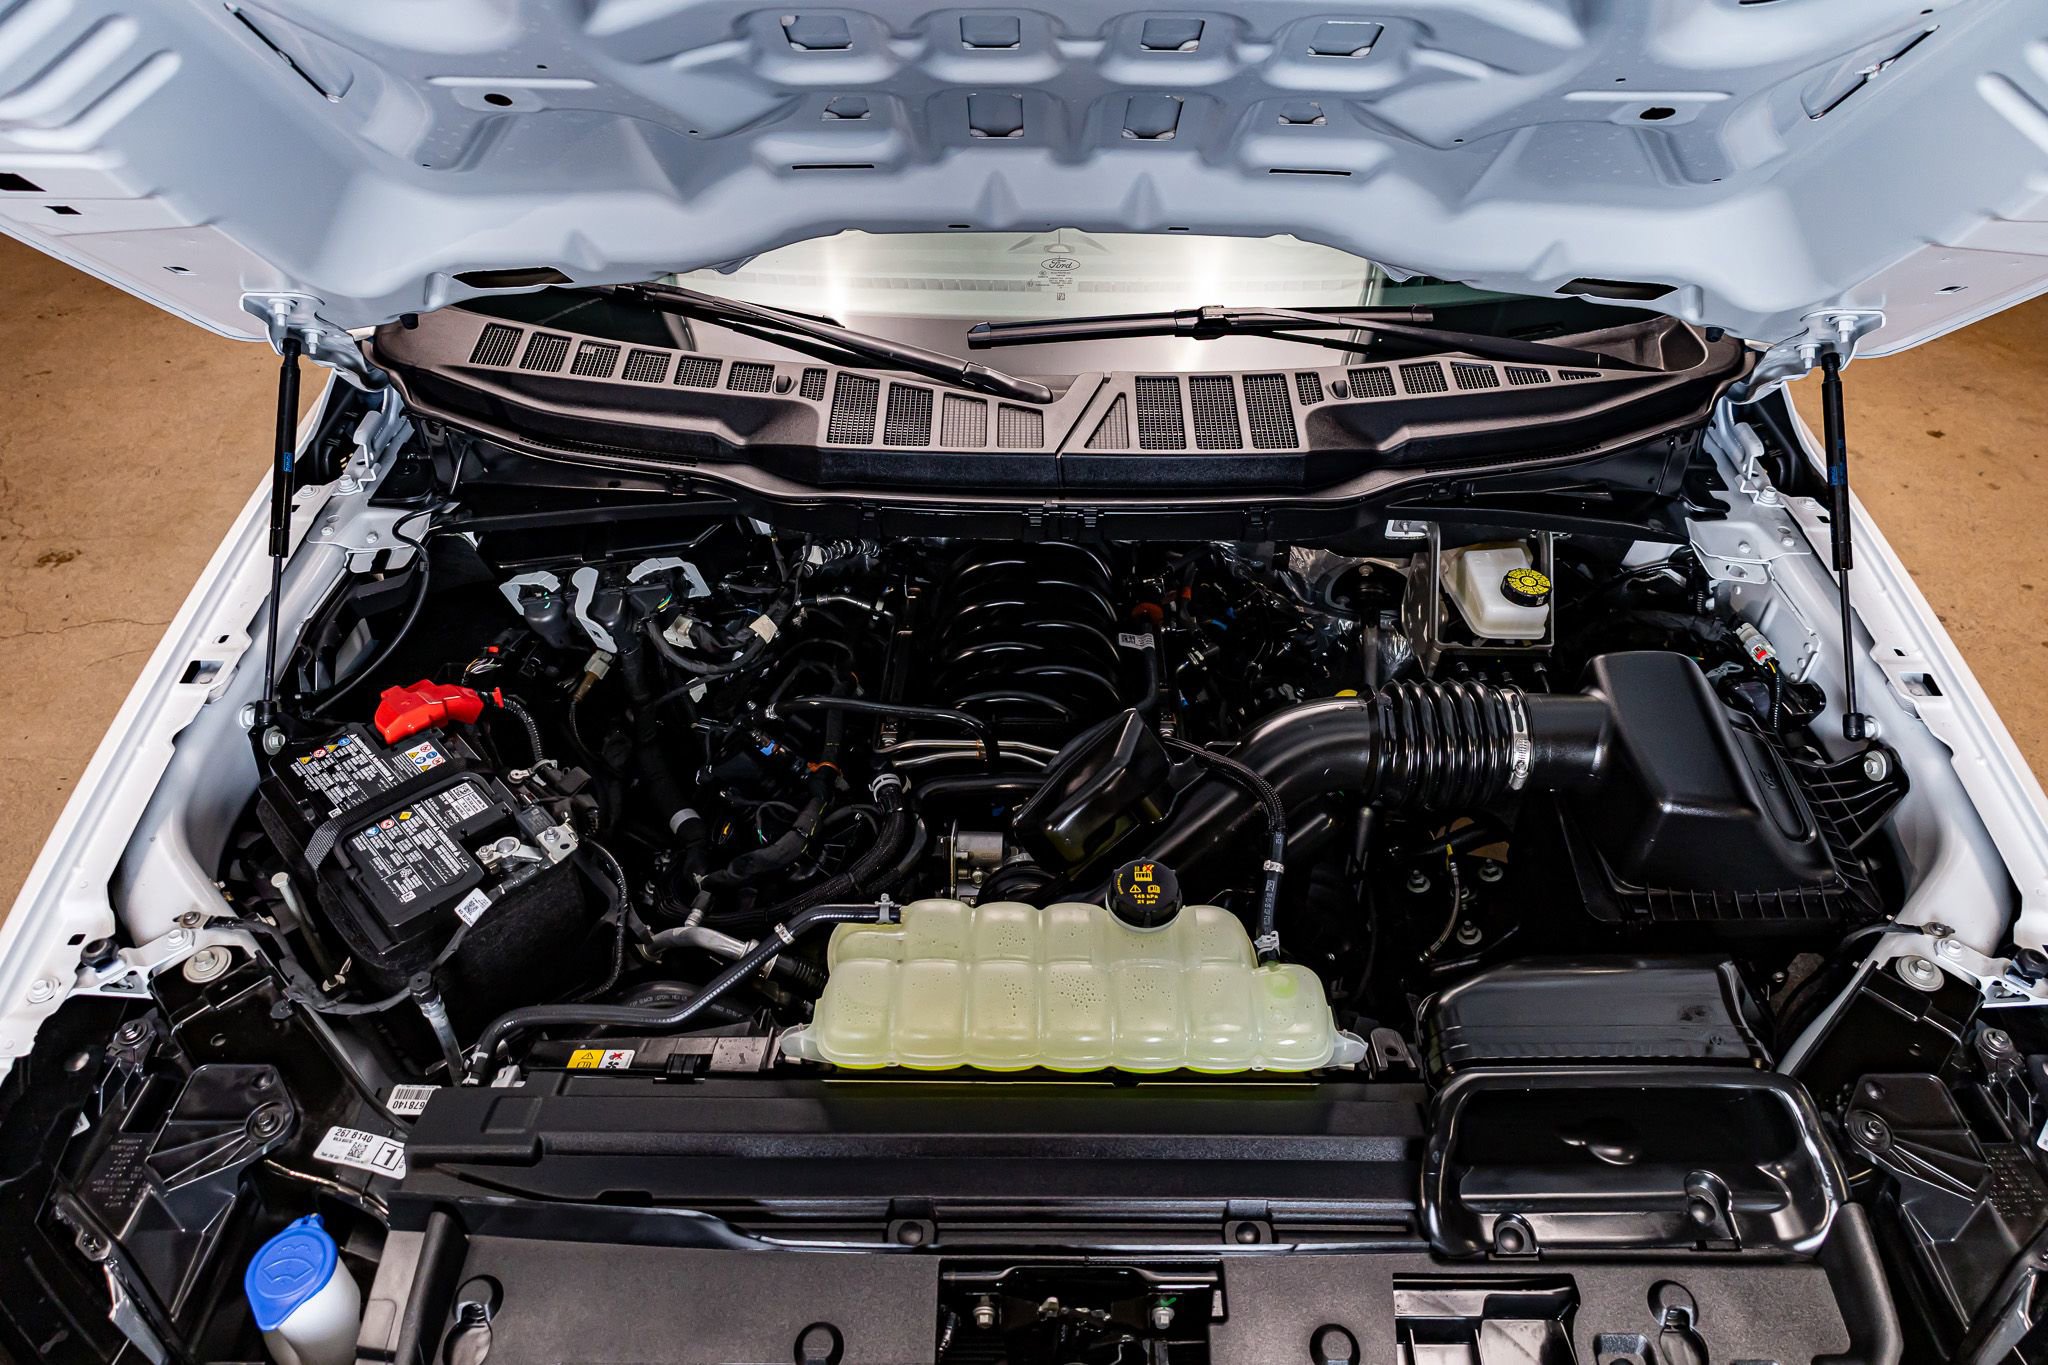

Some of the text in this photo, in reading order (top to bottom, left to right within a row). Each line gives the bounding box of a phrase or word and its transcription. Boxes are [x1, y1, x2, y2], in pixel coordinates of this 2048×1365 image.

[392, 1100, 426, 1110] 678140
[334, 1128, 351, 1138] 267
[351, 1131, 374, 1143] 8140
[383, 1148, 397, 1166] 1
